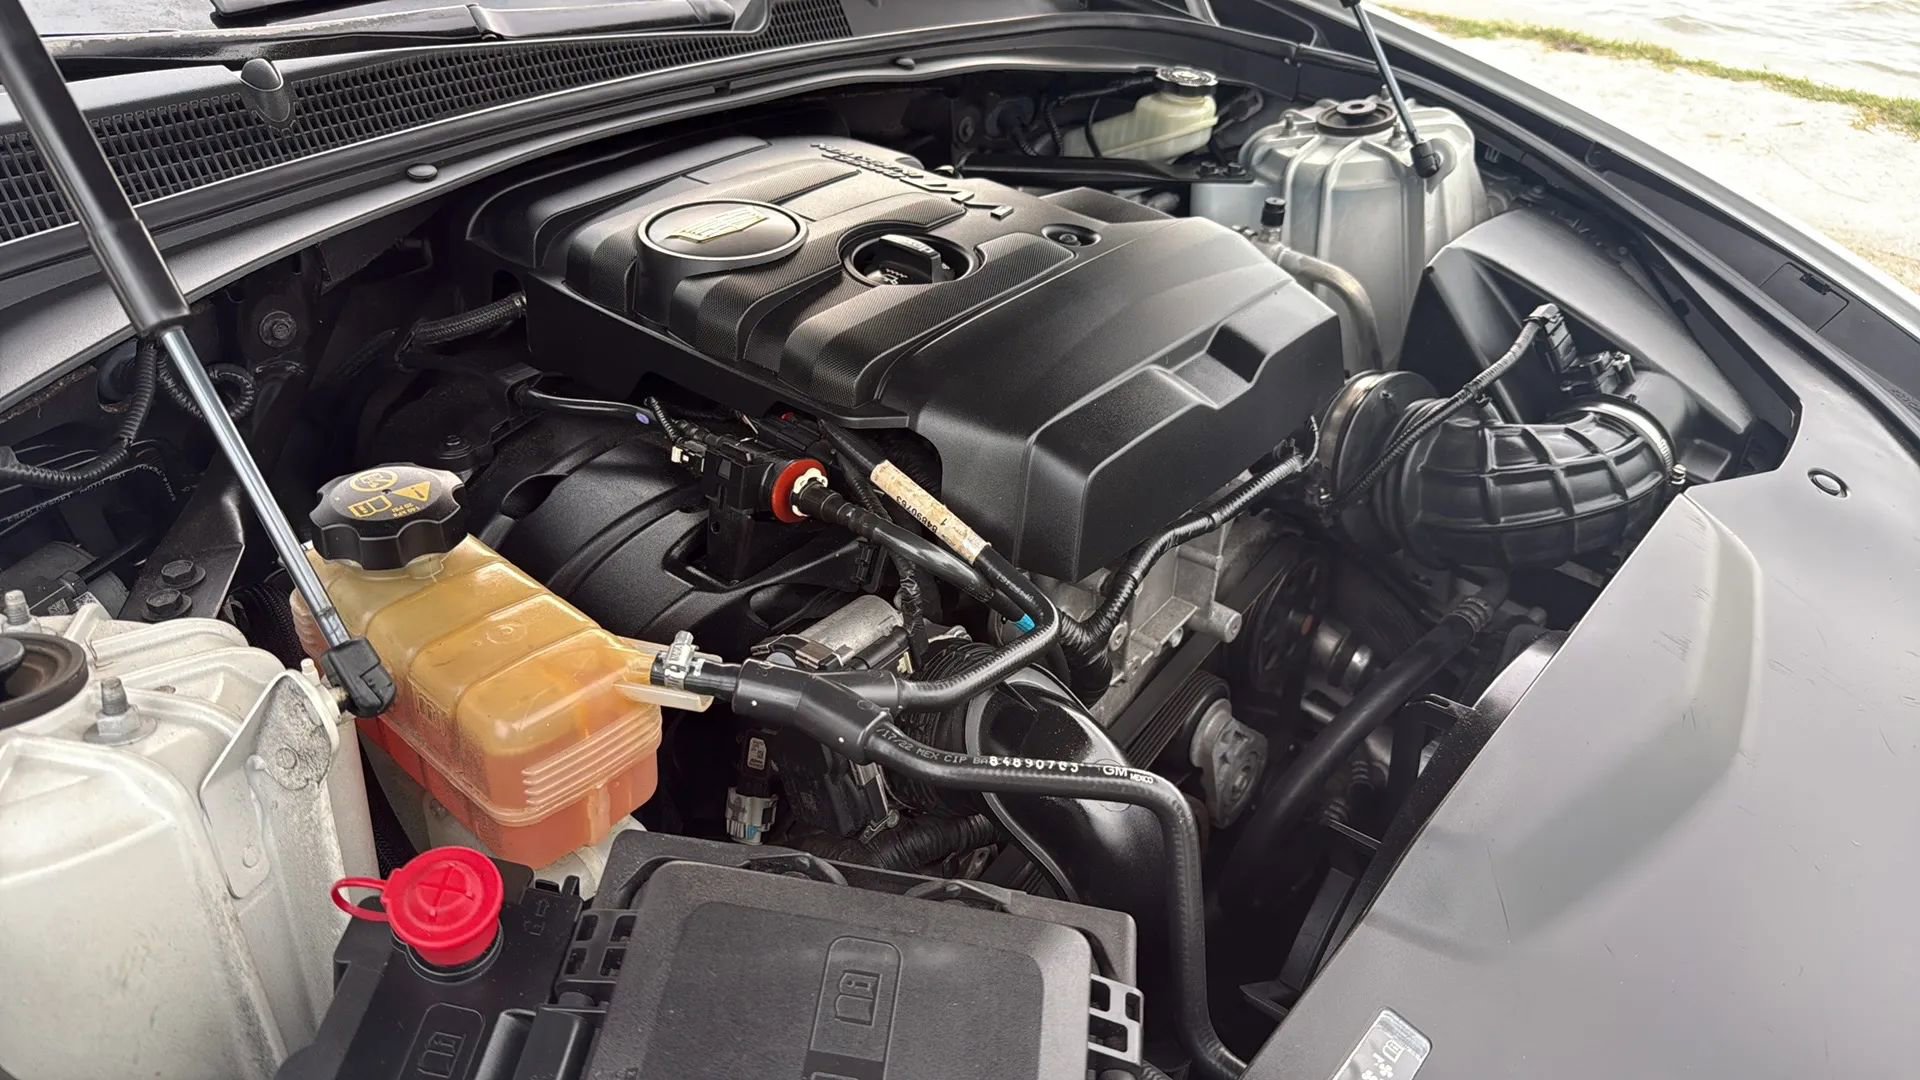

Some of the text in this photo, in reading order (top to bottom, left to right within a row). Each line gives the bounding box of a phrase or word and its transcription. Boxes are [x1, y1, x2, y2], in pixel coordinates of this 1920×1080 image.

[916, 747, 940, 760] MEX
[943, 754, 967, 764] CIP
[1102, 765, 1154, 784] GM MEXICO
